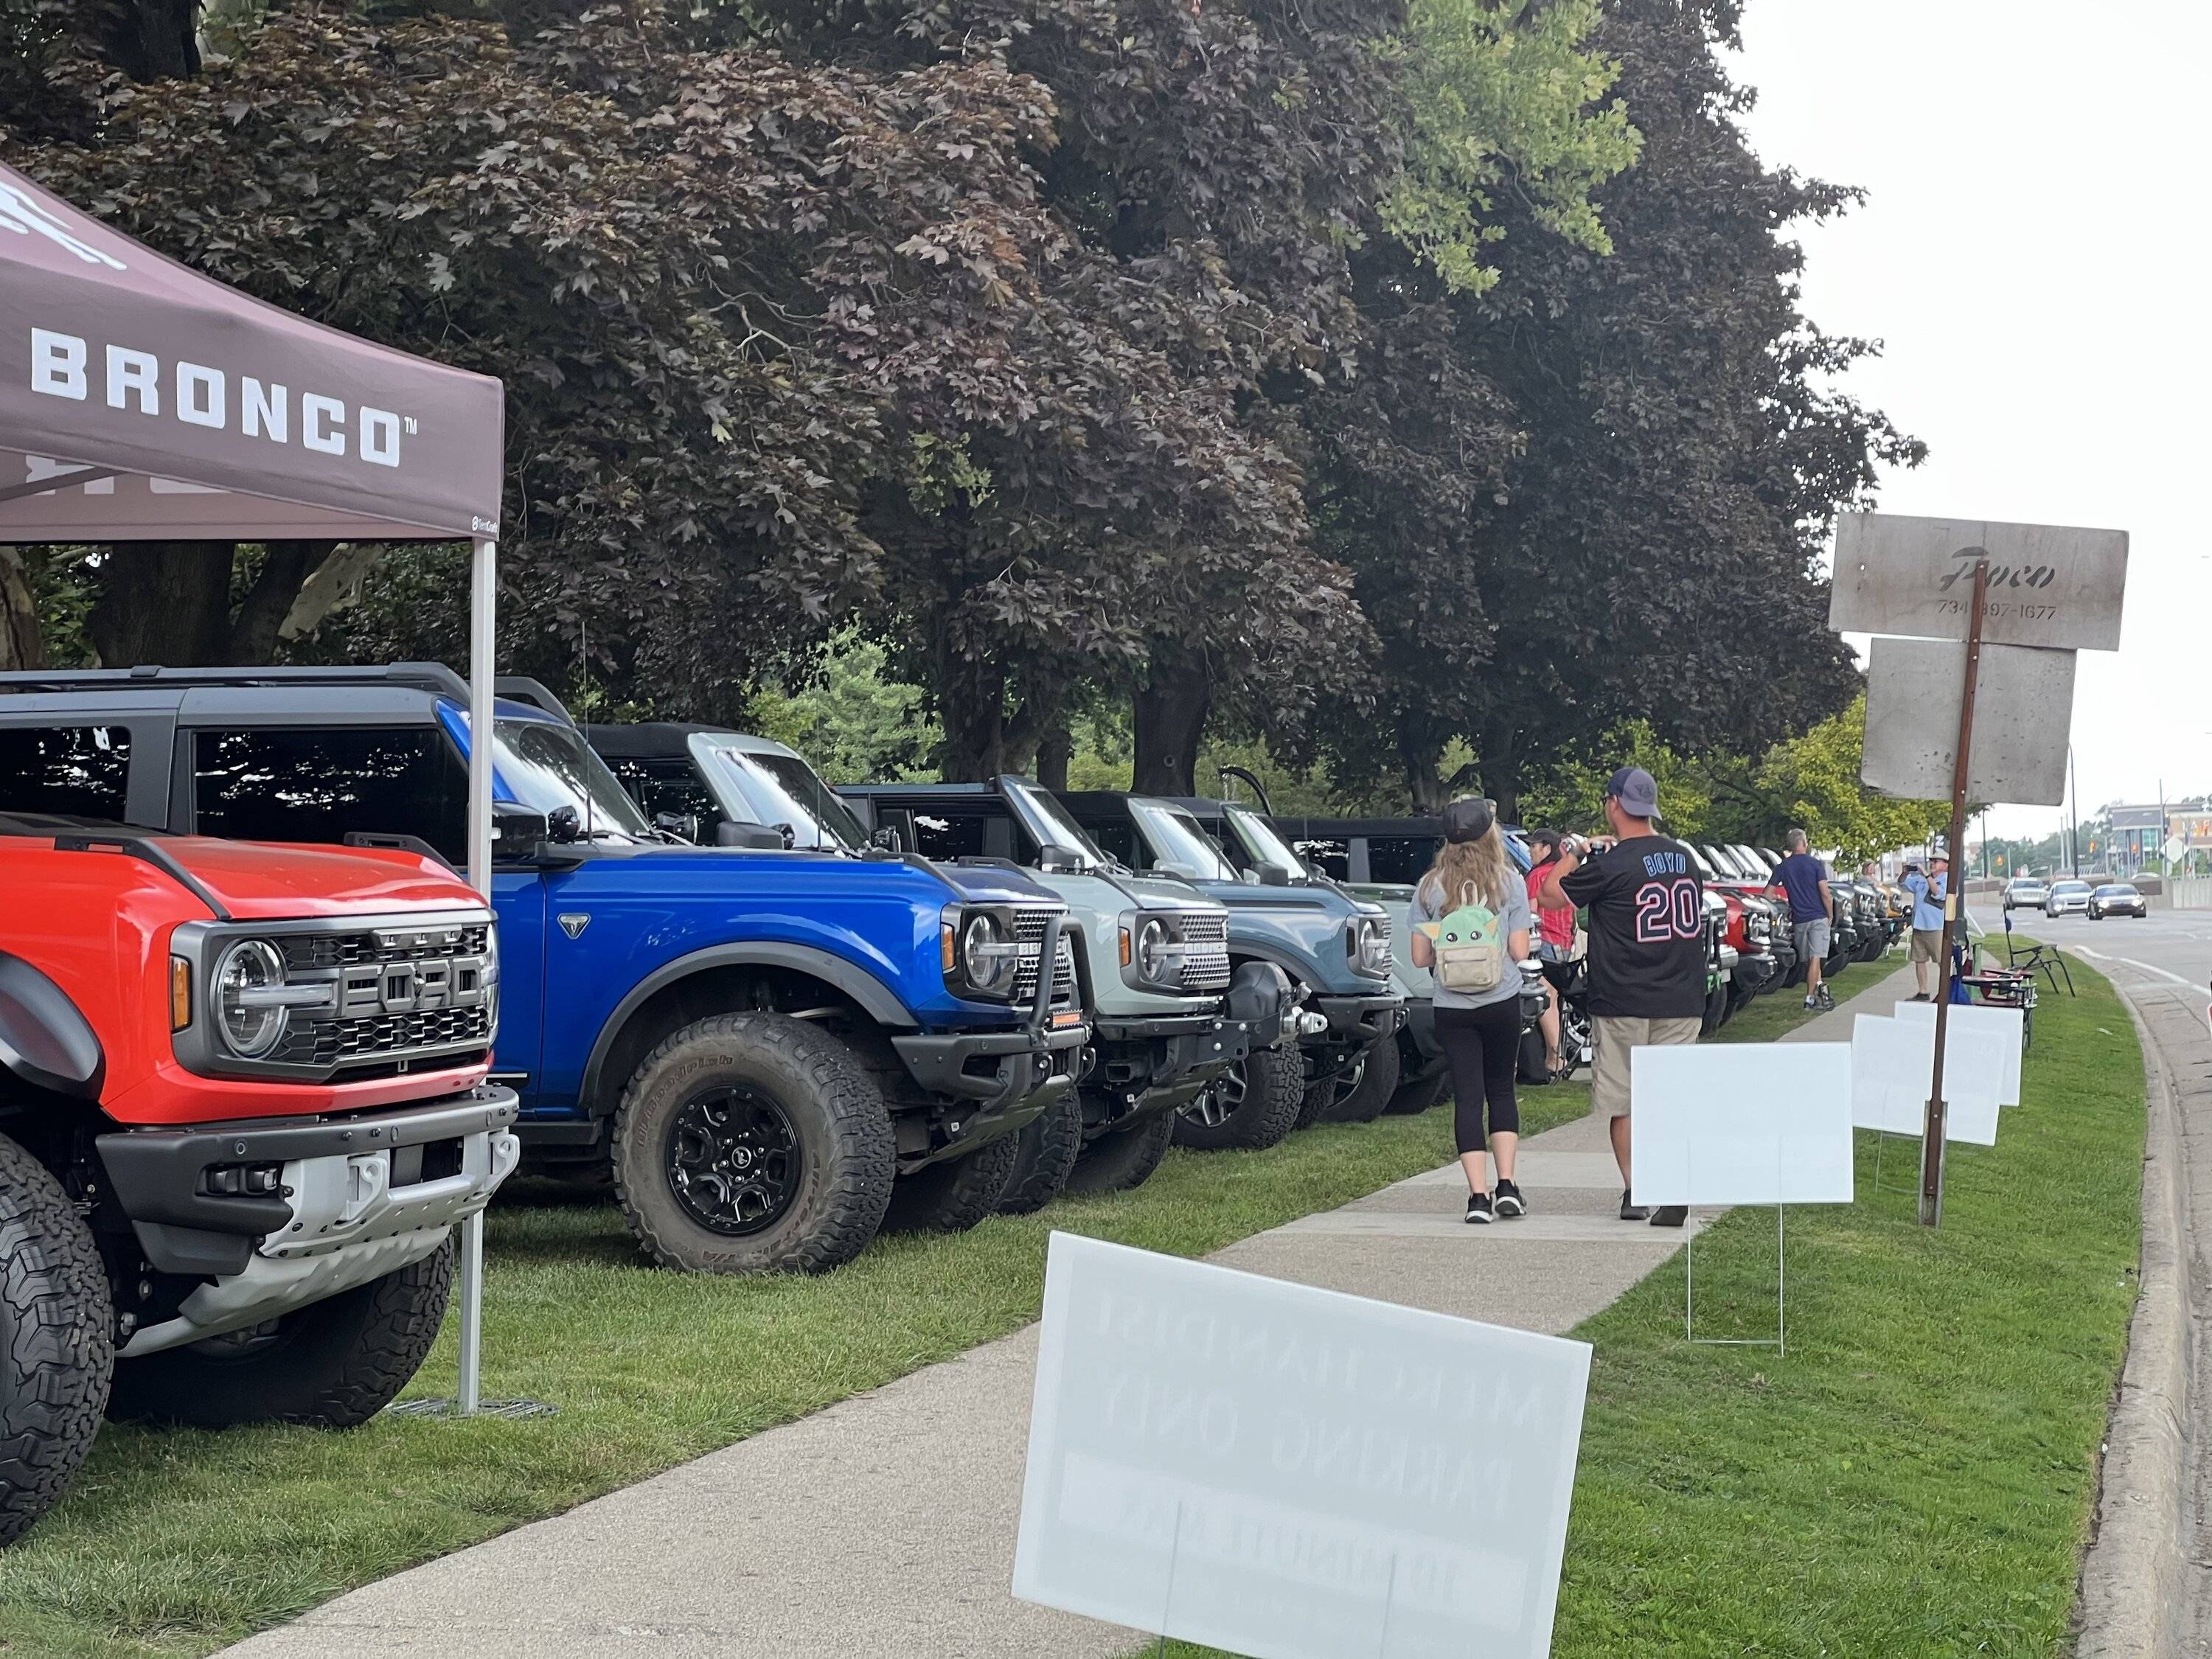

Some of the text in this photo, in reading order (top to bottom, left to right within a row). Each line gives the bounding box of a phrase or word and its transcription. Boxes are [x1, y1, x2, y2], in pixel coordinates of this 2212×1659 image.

[1643, 852, 1687, 877] BOYD
[1635, 877, 1702, 944] 20
[341, 955, 485, 1018] FORD
